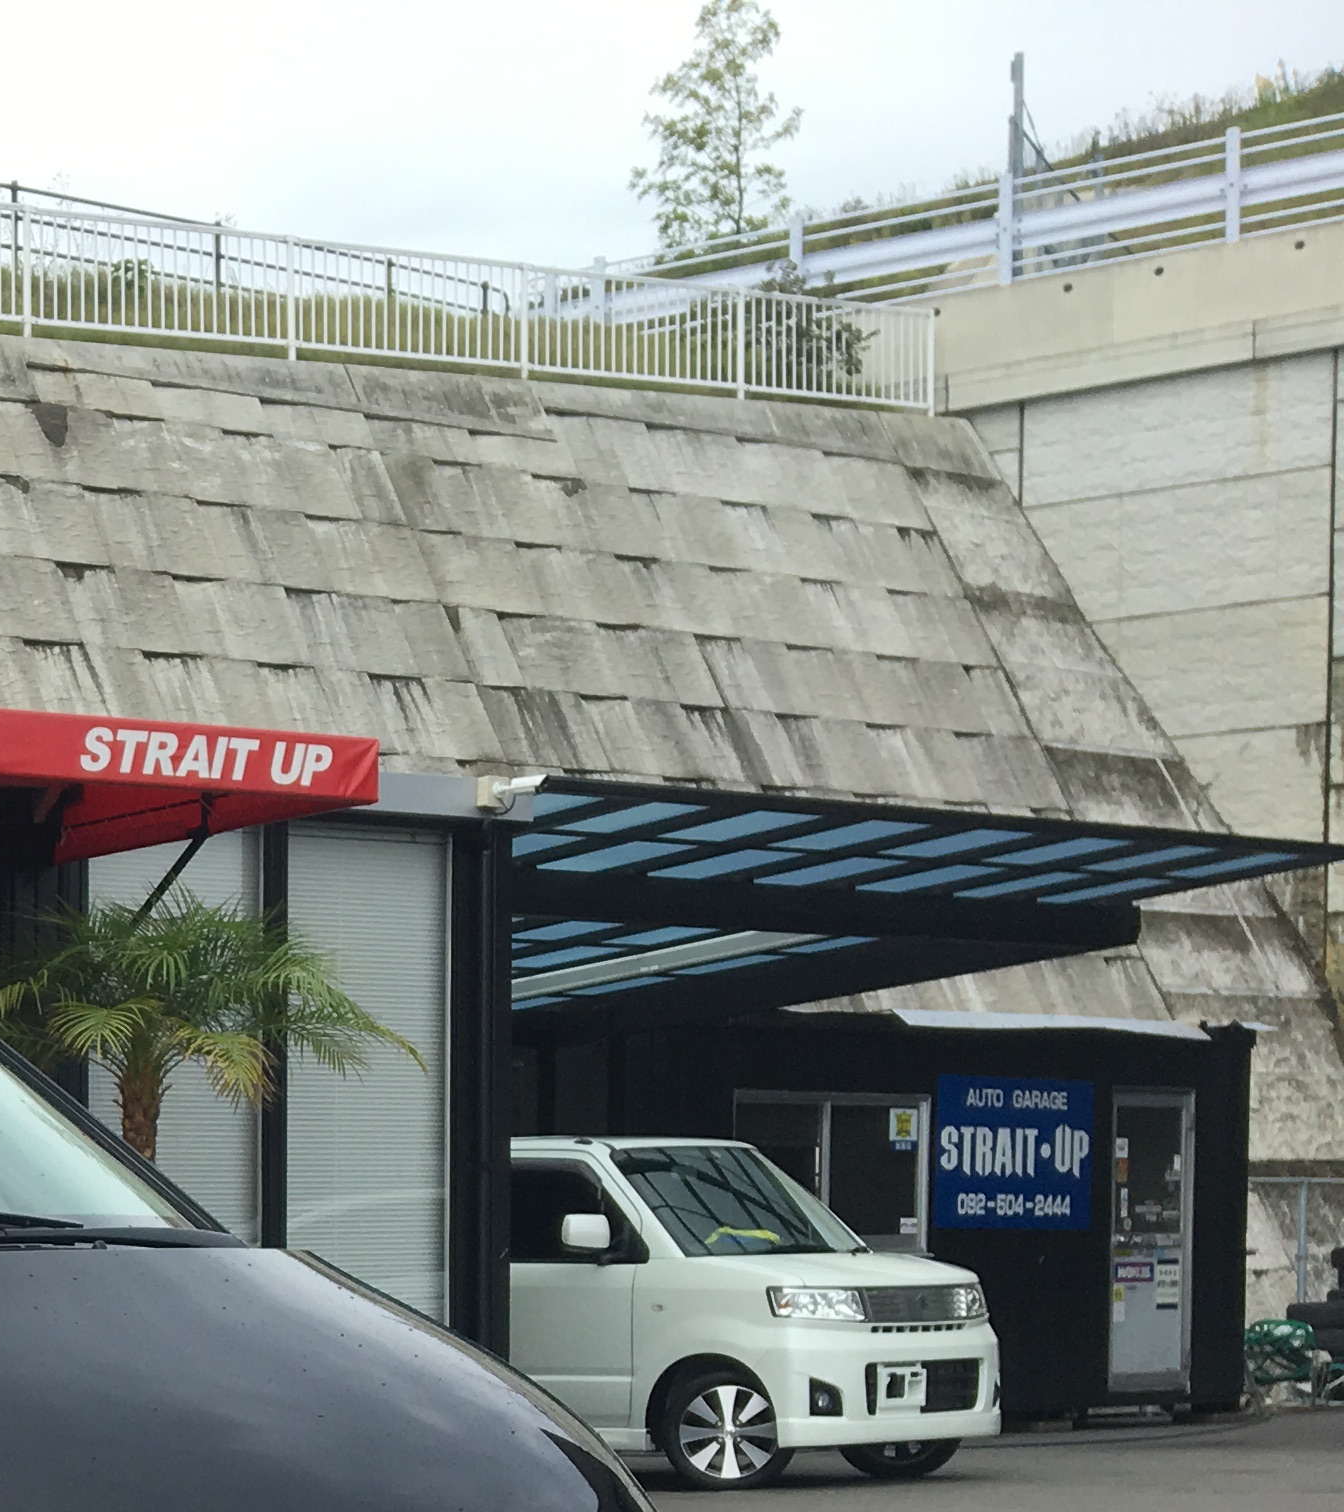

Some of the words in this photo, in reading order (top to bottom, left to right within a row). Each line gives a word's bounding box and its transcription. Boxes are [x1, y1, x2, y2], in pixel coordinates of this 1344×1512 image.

[79, 726, 260, 781] STRAIT
[270, 740, 333, 787] UP
[966, 1088, 1004, 1108] AUTO
[1013, 1090, 1068, 1111] GARAGE
[957, 1192, 1071, 1216] 092-504-2444
